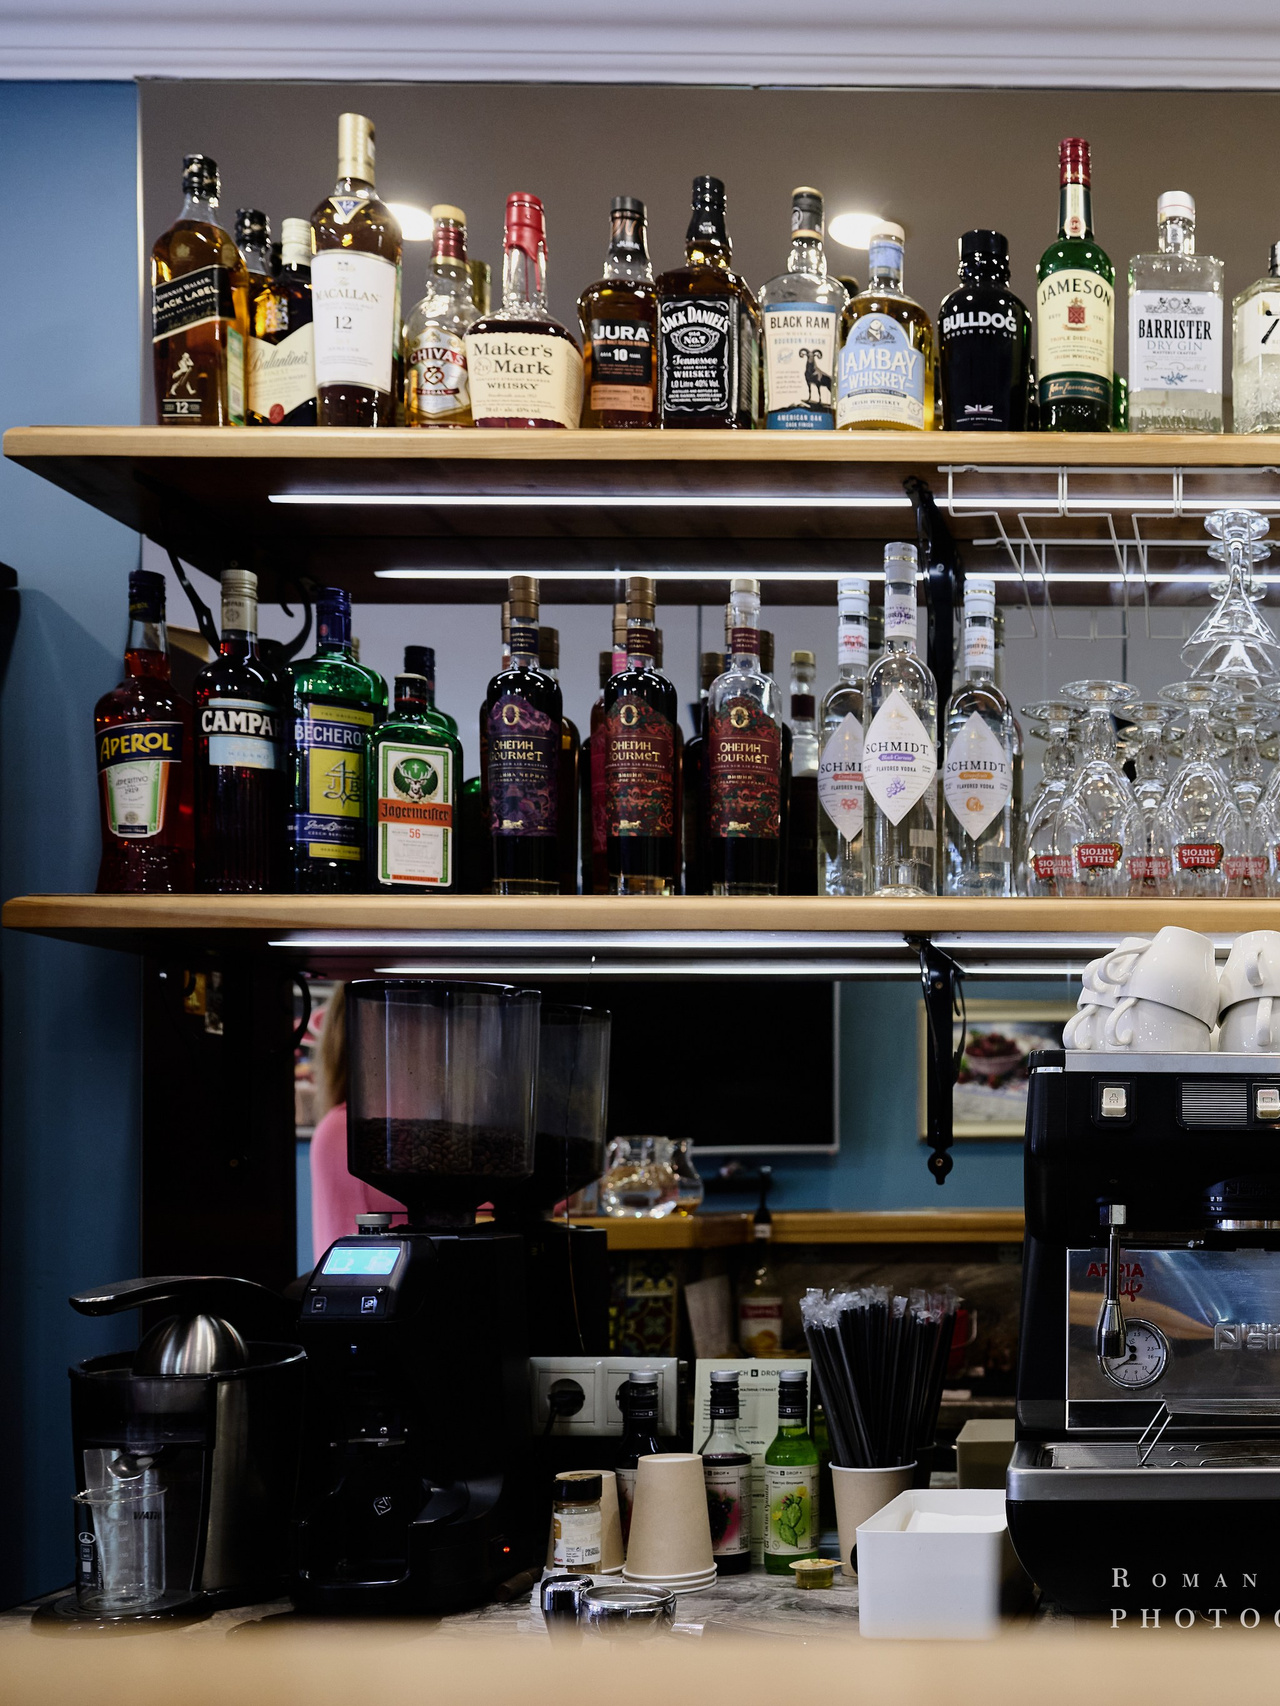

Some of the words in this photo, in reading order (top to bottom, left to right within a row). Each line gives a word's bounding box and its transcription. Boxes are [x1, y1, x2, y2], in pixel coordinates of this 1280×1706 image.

[314, 288, 380, 304] MACALLAN
[1041, 278, 1111, 307] JAMESON
[152, 298, 184, 314] BLACK
[185, 285, 219, 302] LABEL
[335, 316, 353, 330] 12
[661, 310, 686, 334] JACK
[687, 305, 731, 334] DANIEL'S
[770, 316, 802, 329] BLACK
[806, 316, 830, 329] RAM
[943, 311, 1017, 334] BULLDOG
[593, 325, 650, 342] JURA
[943, 329, 973, 341] LONDON
[1003, 332, 1017, 340] GIN
[1138, 318, 1212, 340] BARRISTER
[473, 342, 553, 358] Maker's
[1147, 340, 1173, 351] DRY
[1177, 340, 1203, 351] GIN
[410, 348, 465, 367] CHIVAS
[672, 354, 718, 366] Tennessee
[841, 348, 918, 380] LAMBAY
[494, 360, 552, 376] Mark
[673, 370, 717, 378] WHISKEY
[487, 382, 540, 391] WHISKY
[848, 371, 907, 390] WHISKEY
[175, 402, 189, 414] 12
[777, 414, 808, 422] AMERICAN
[294, 724, 365, 746] BECHERO
[100, 732, 173, 762] APEROL
[493, 740, 534, 751] ОНЕГИН
[611, 740, 652, 751] ОНЕГИН
[719, 741, 762, 753] ОНЕГИН
[609, 751, 661, 763] OURMET
[820, 761, 863, 774] SCHMI
[409, 828, 421, 839] 56
[1080, 847, 1115, 856] ARTOIS
[1181, 848, 1216, 857] ARTOIS
[1081, 855, 1115, 864] STELLA
[1182, 856, 1216, 864] STELLA
